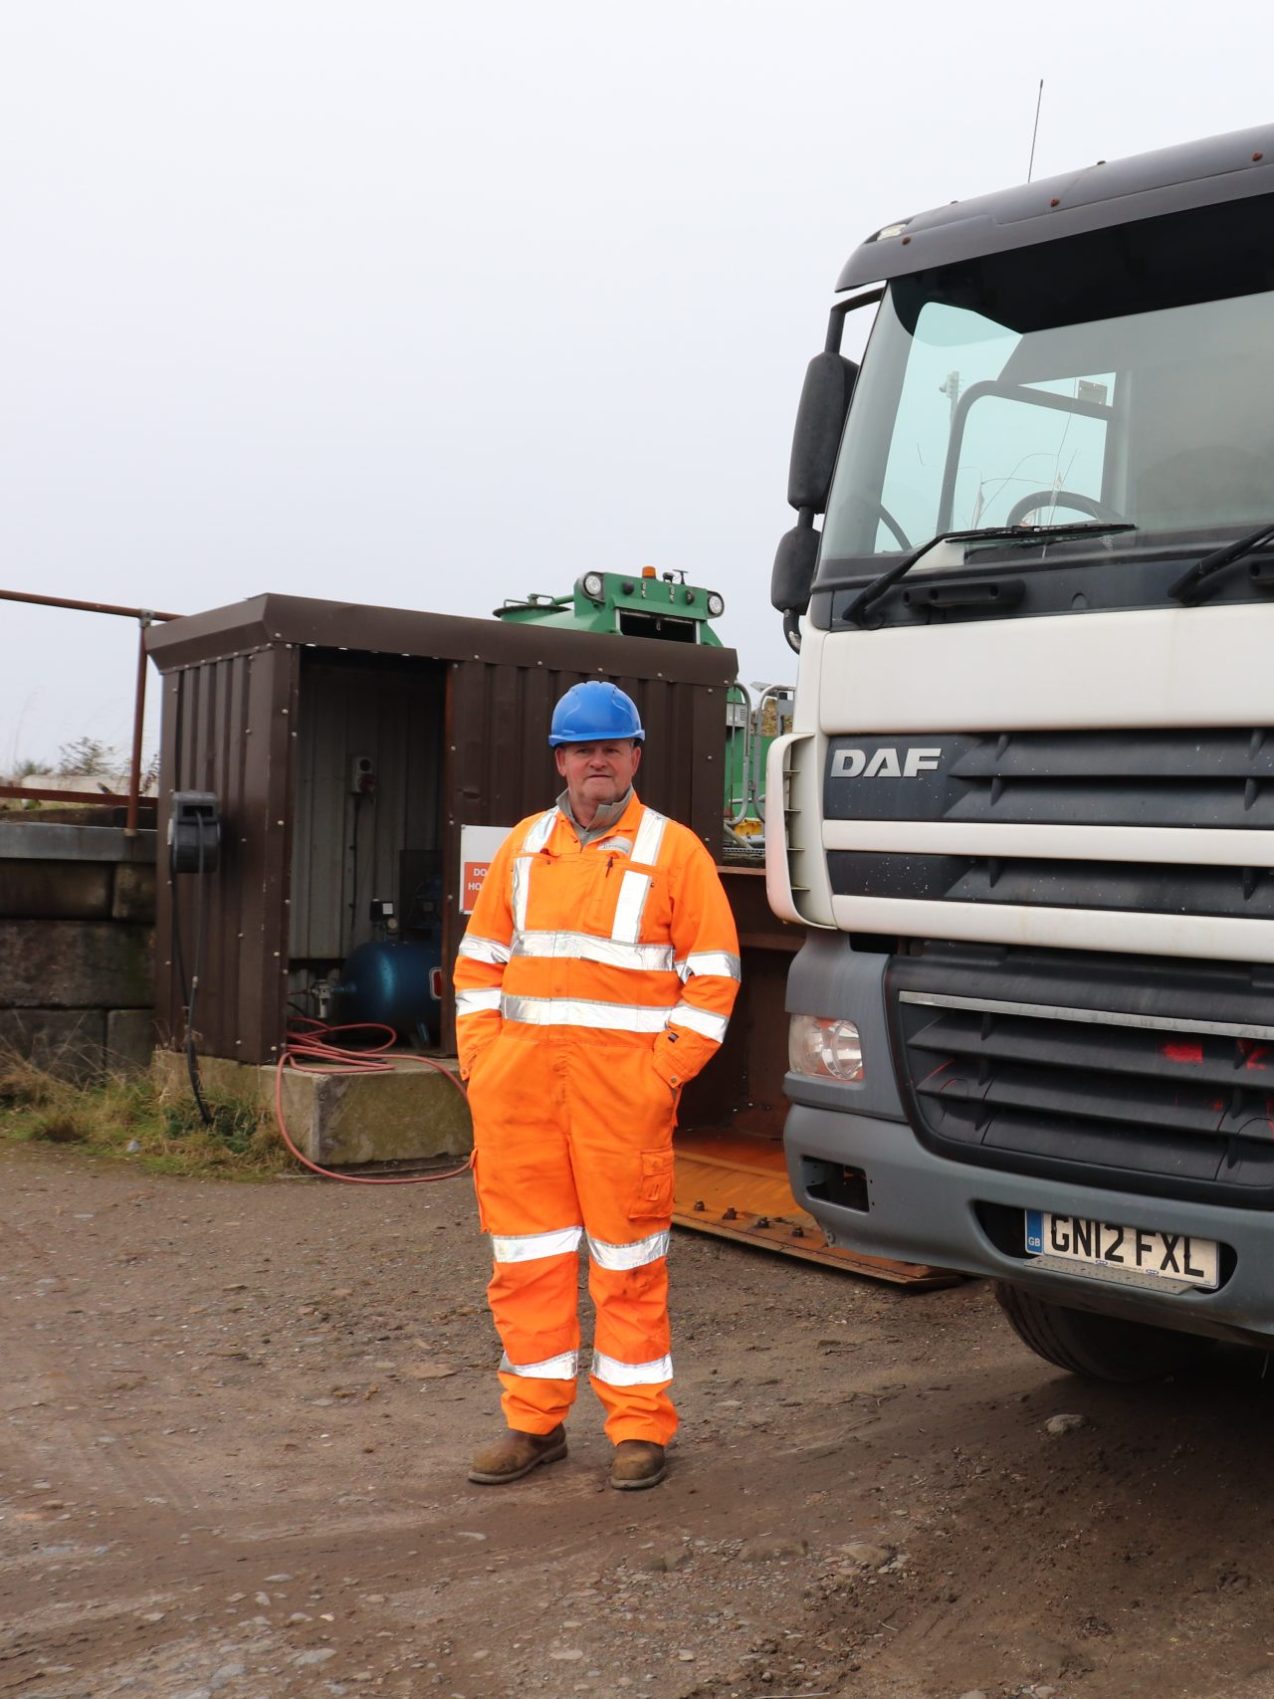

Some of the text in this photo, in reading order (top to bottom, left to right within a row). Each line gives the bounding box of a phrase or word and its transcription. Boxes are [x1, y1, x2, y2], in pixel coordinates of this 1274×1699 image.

[830, 748, 942, 777] DAF
[467, 882, 482, 891] HO
[1028, 1237, 1041, 1247] GB
[1051, 1214, 1204, 1278] GN12 FXL
